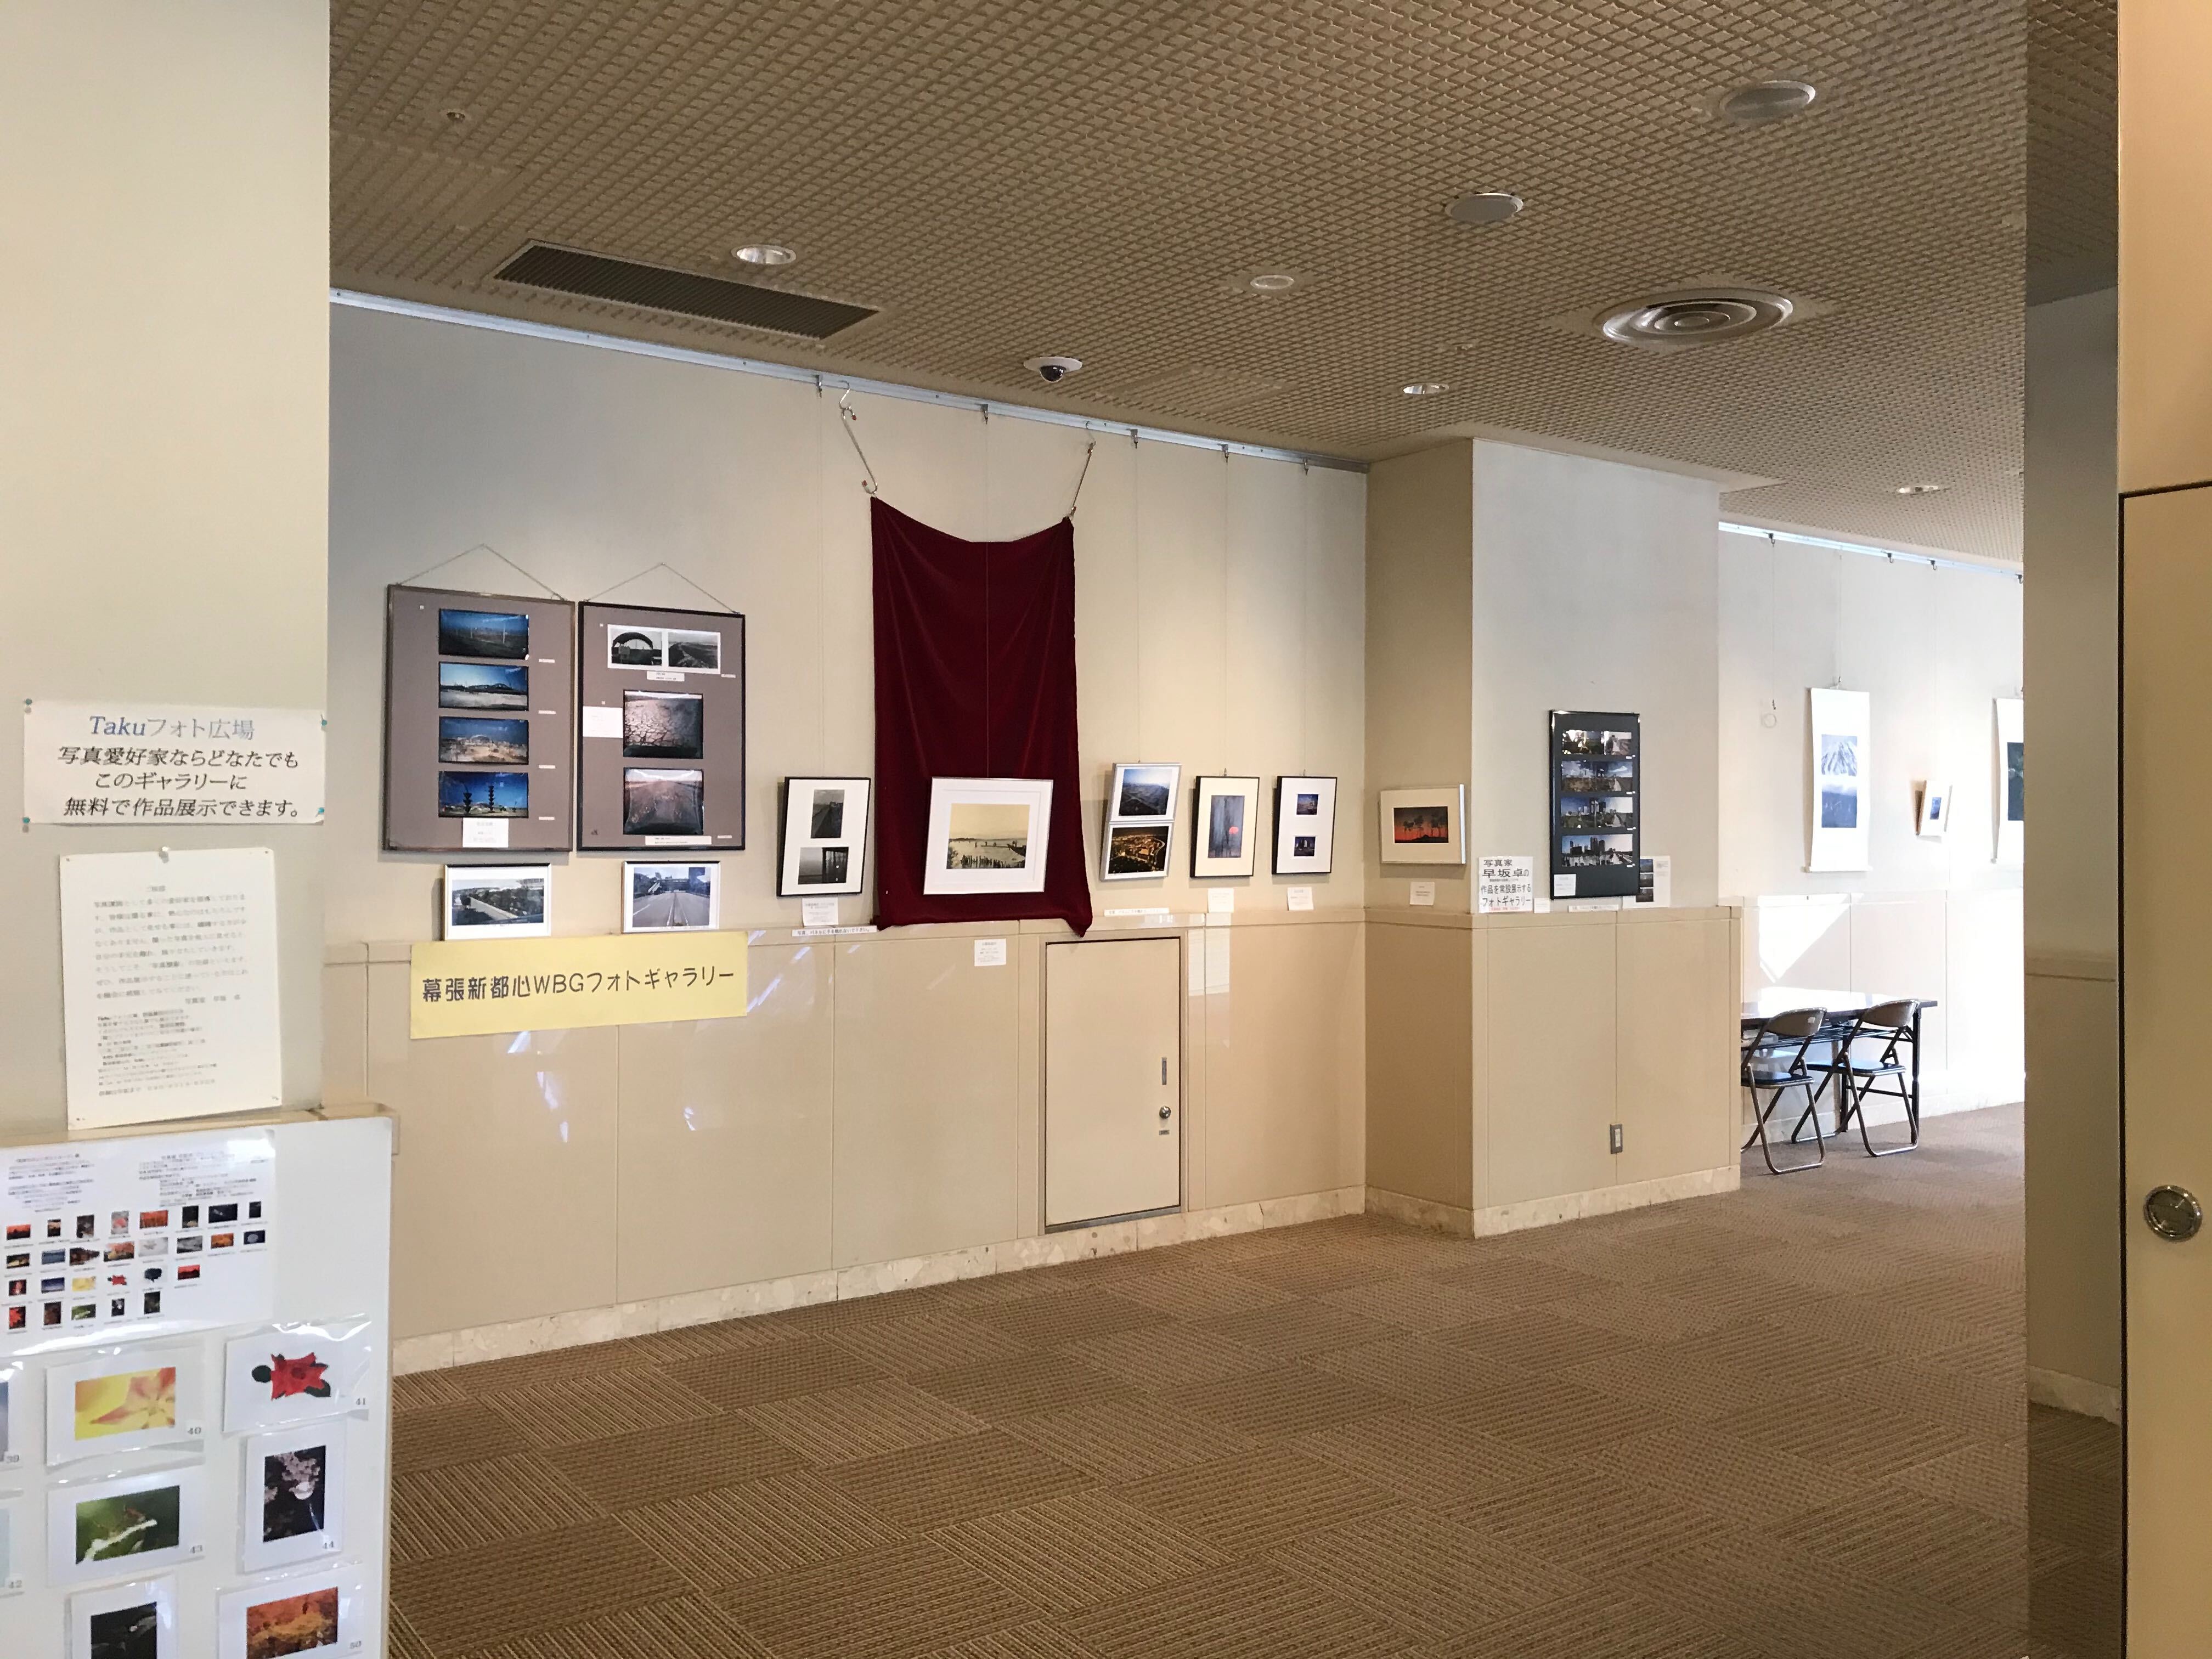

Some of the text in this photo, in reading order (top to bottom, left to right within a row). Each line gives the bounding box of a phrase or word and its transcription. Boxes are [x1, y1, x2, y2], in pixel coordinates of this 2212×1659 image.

[90, 715, 255, 740] Takuフォト広場
[58, 746, 298, 768] 写真愛好家ならどなたでも
[95, 771, 247, 791] このギャラリーに
[63, 797, 298, 817] 無料で作品展示できます。
[1481, 884, 1532, 894] 作品を常設展示する
[1482, 896, 1531, 907] フォトギャラリー
[422, 966, 734, 1003] 幕張新都心WBGフォトギャラリー
[356, 1397, 366, 1406] 41
